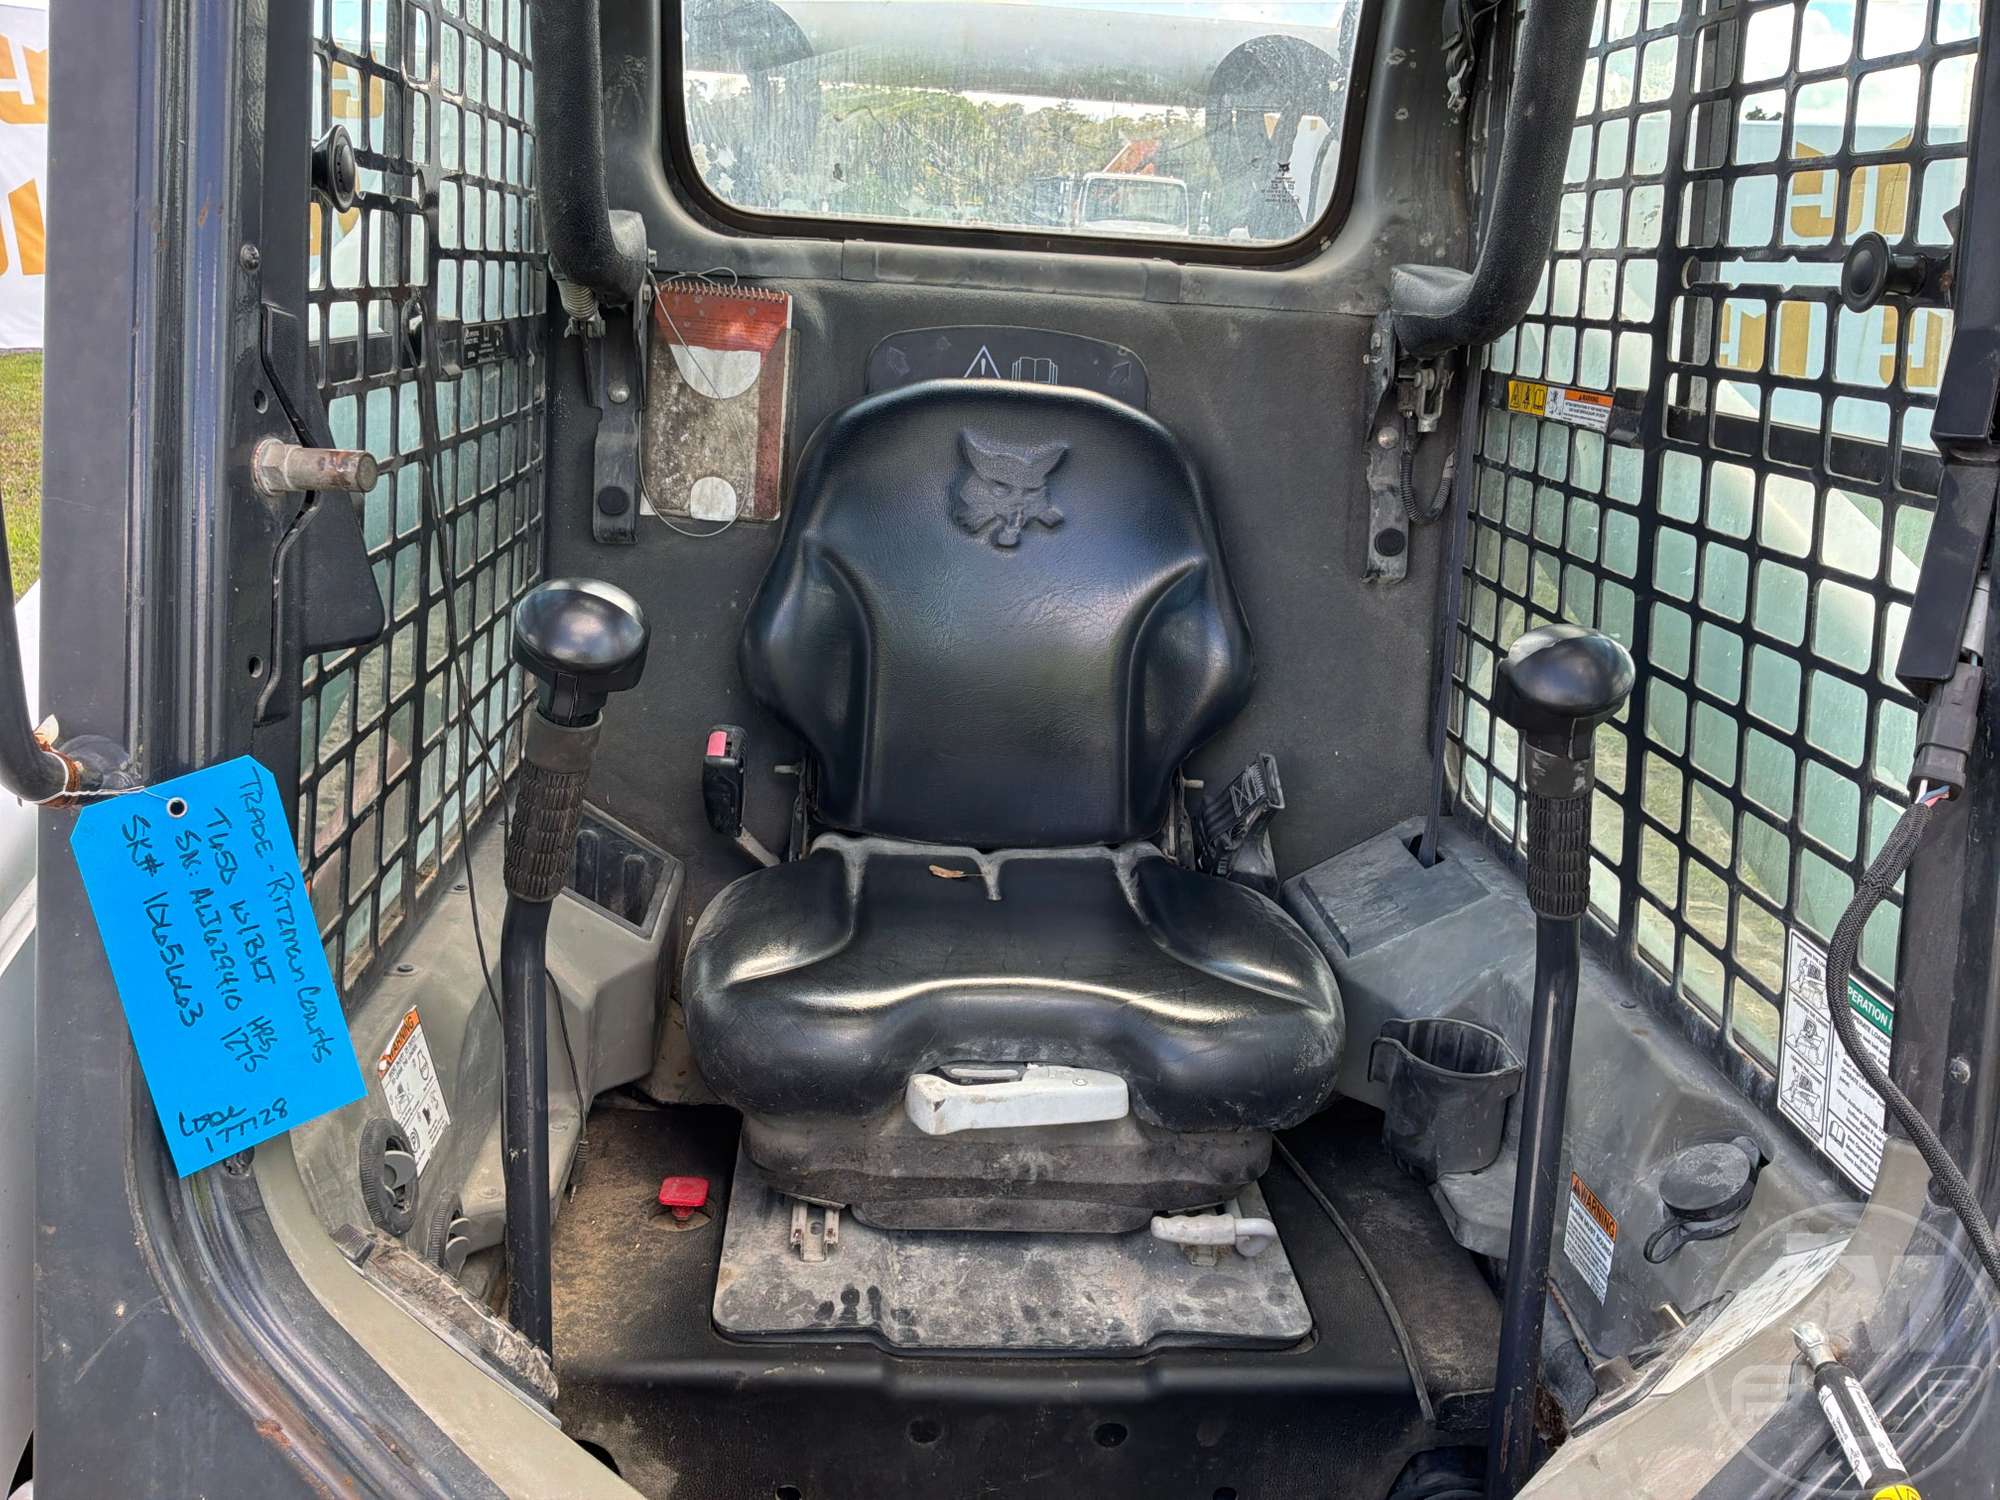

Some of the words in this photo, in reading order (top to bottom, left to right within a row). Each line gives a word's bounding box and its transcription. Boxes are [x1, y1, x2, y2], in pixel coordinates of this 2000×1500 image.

[240, 766, 273, 859] TRADE
[1848, 986, 1888, 1026] PERATION
[1580, 1187, 1615, 1238] WARNING
